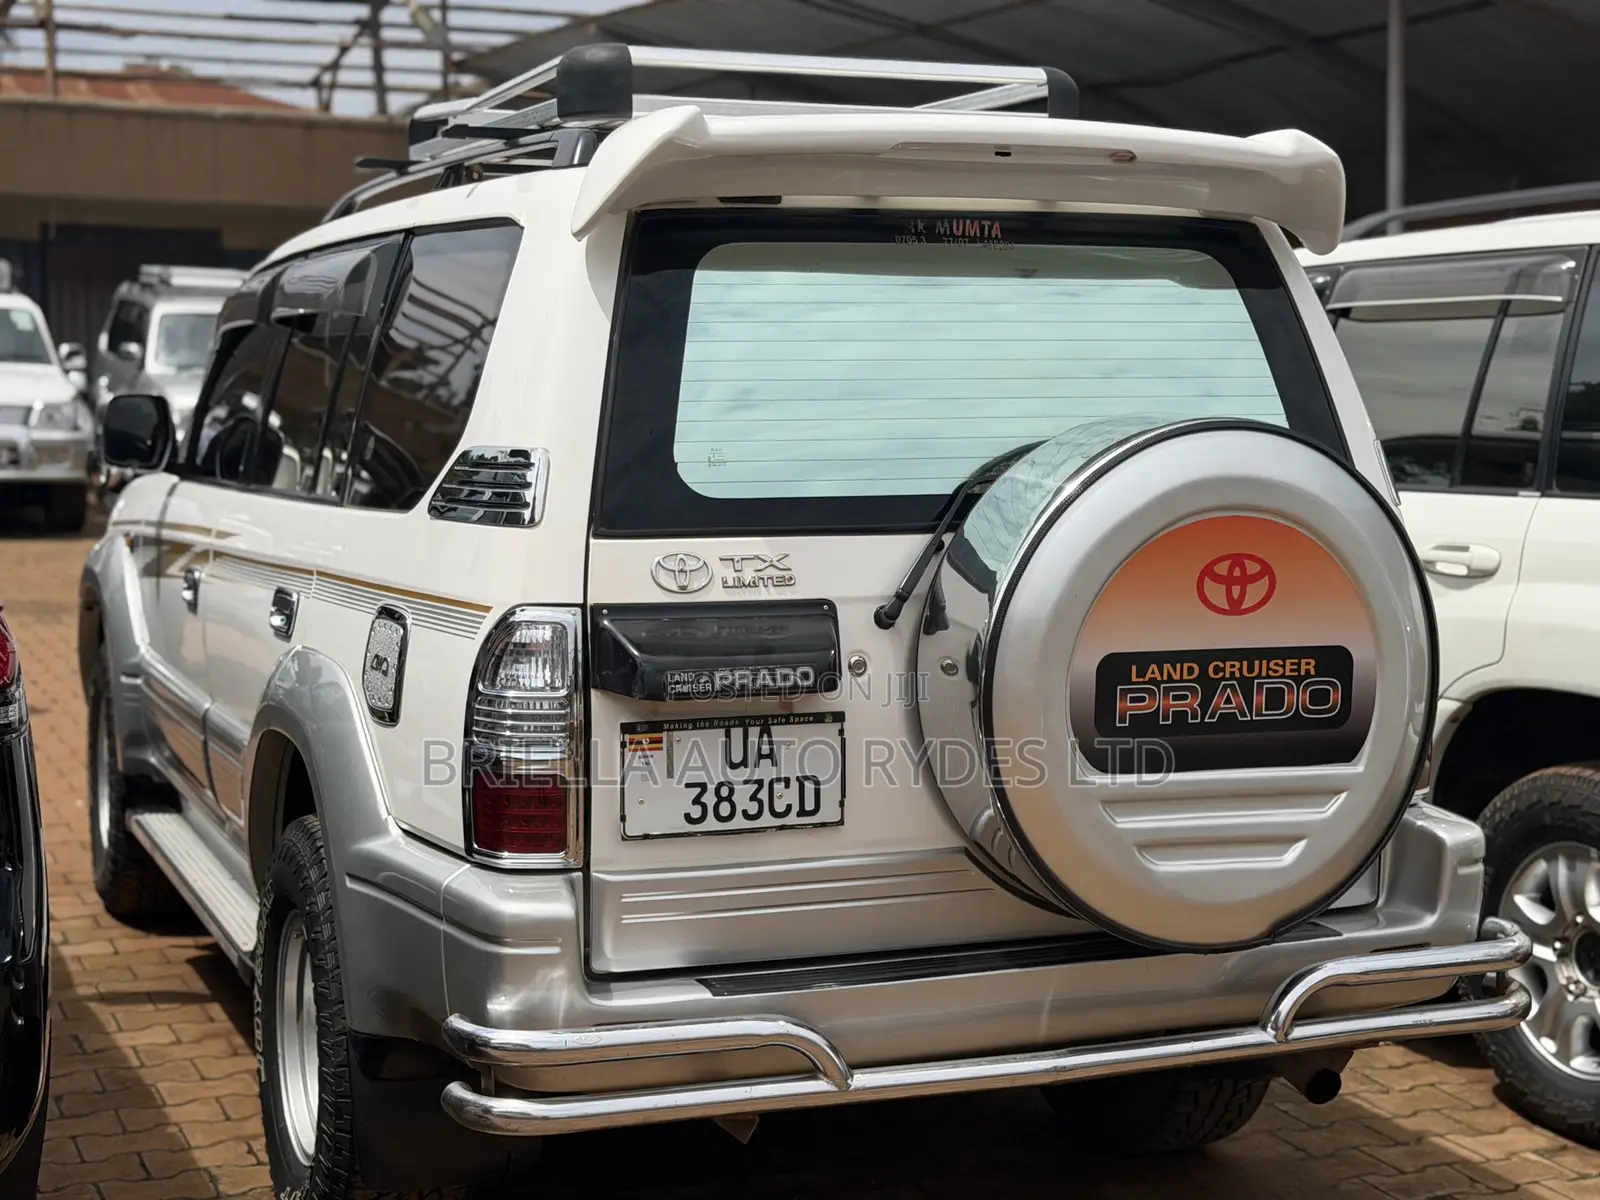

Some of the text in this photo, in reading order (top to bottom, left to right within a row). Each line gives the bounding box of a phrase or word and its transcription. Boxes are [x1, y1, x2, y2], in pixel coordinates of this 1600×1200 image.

[935, 218, 1002, 239] MUMTA
[719, 553, 792, 572] TX
[721, 574, 796, 588] LIMITED
[668, 672, 695, 682] LAND
[714, 666, 815, 692] PRADO
[1131, 658, 1316, 682] LAND CRUISER
[669, 683, 712, 694] CRUISER
[1115, 677, 1341, 727] PRADO
[662, 715, 814, 731] Making the Roads Your Safe Space
[724, 727, 778, 770] UA
[683, 774, 821, 825] 383CD
